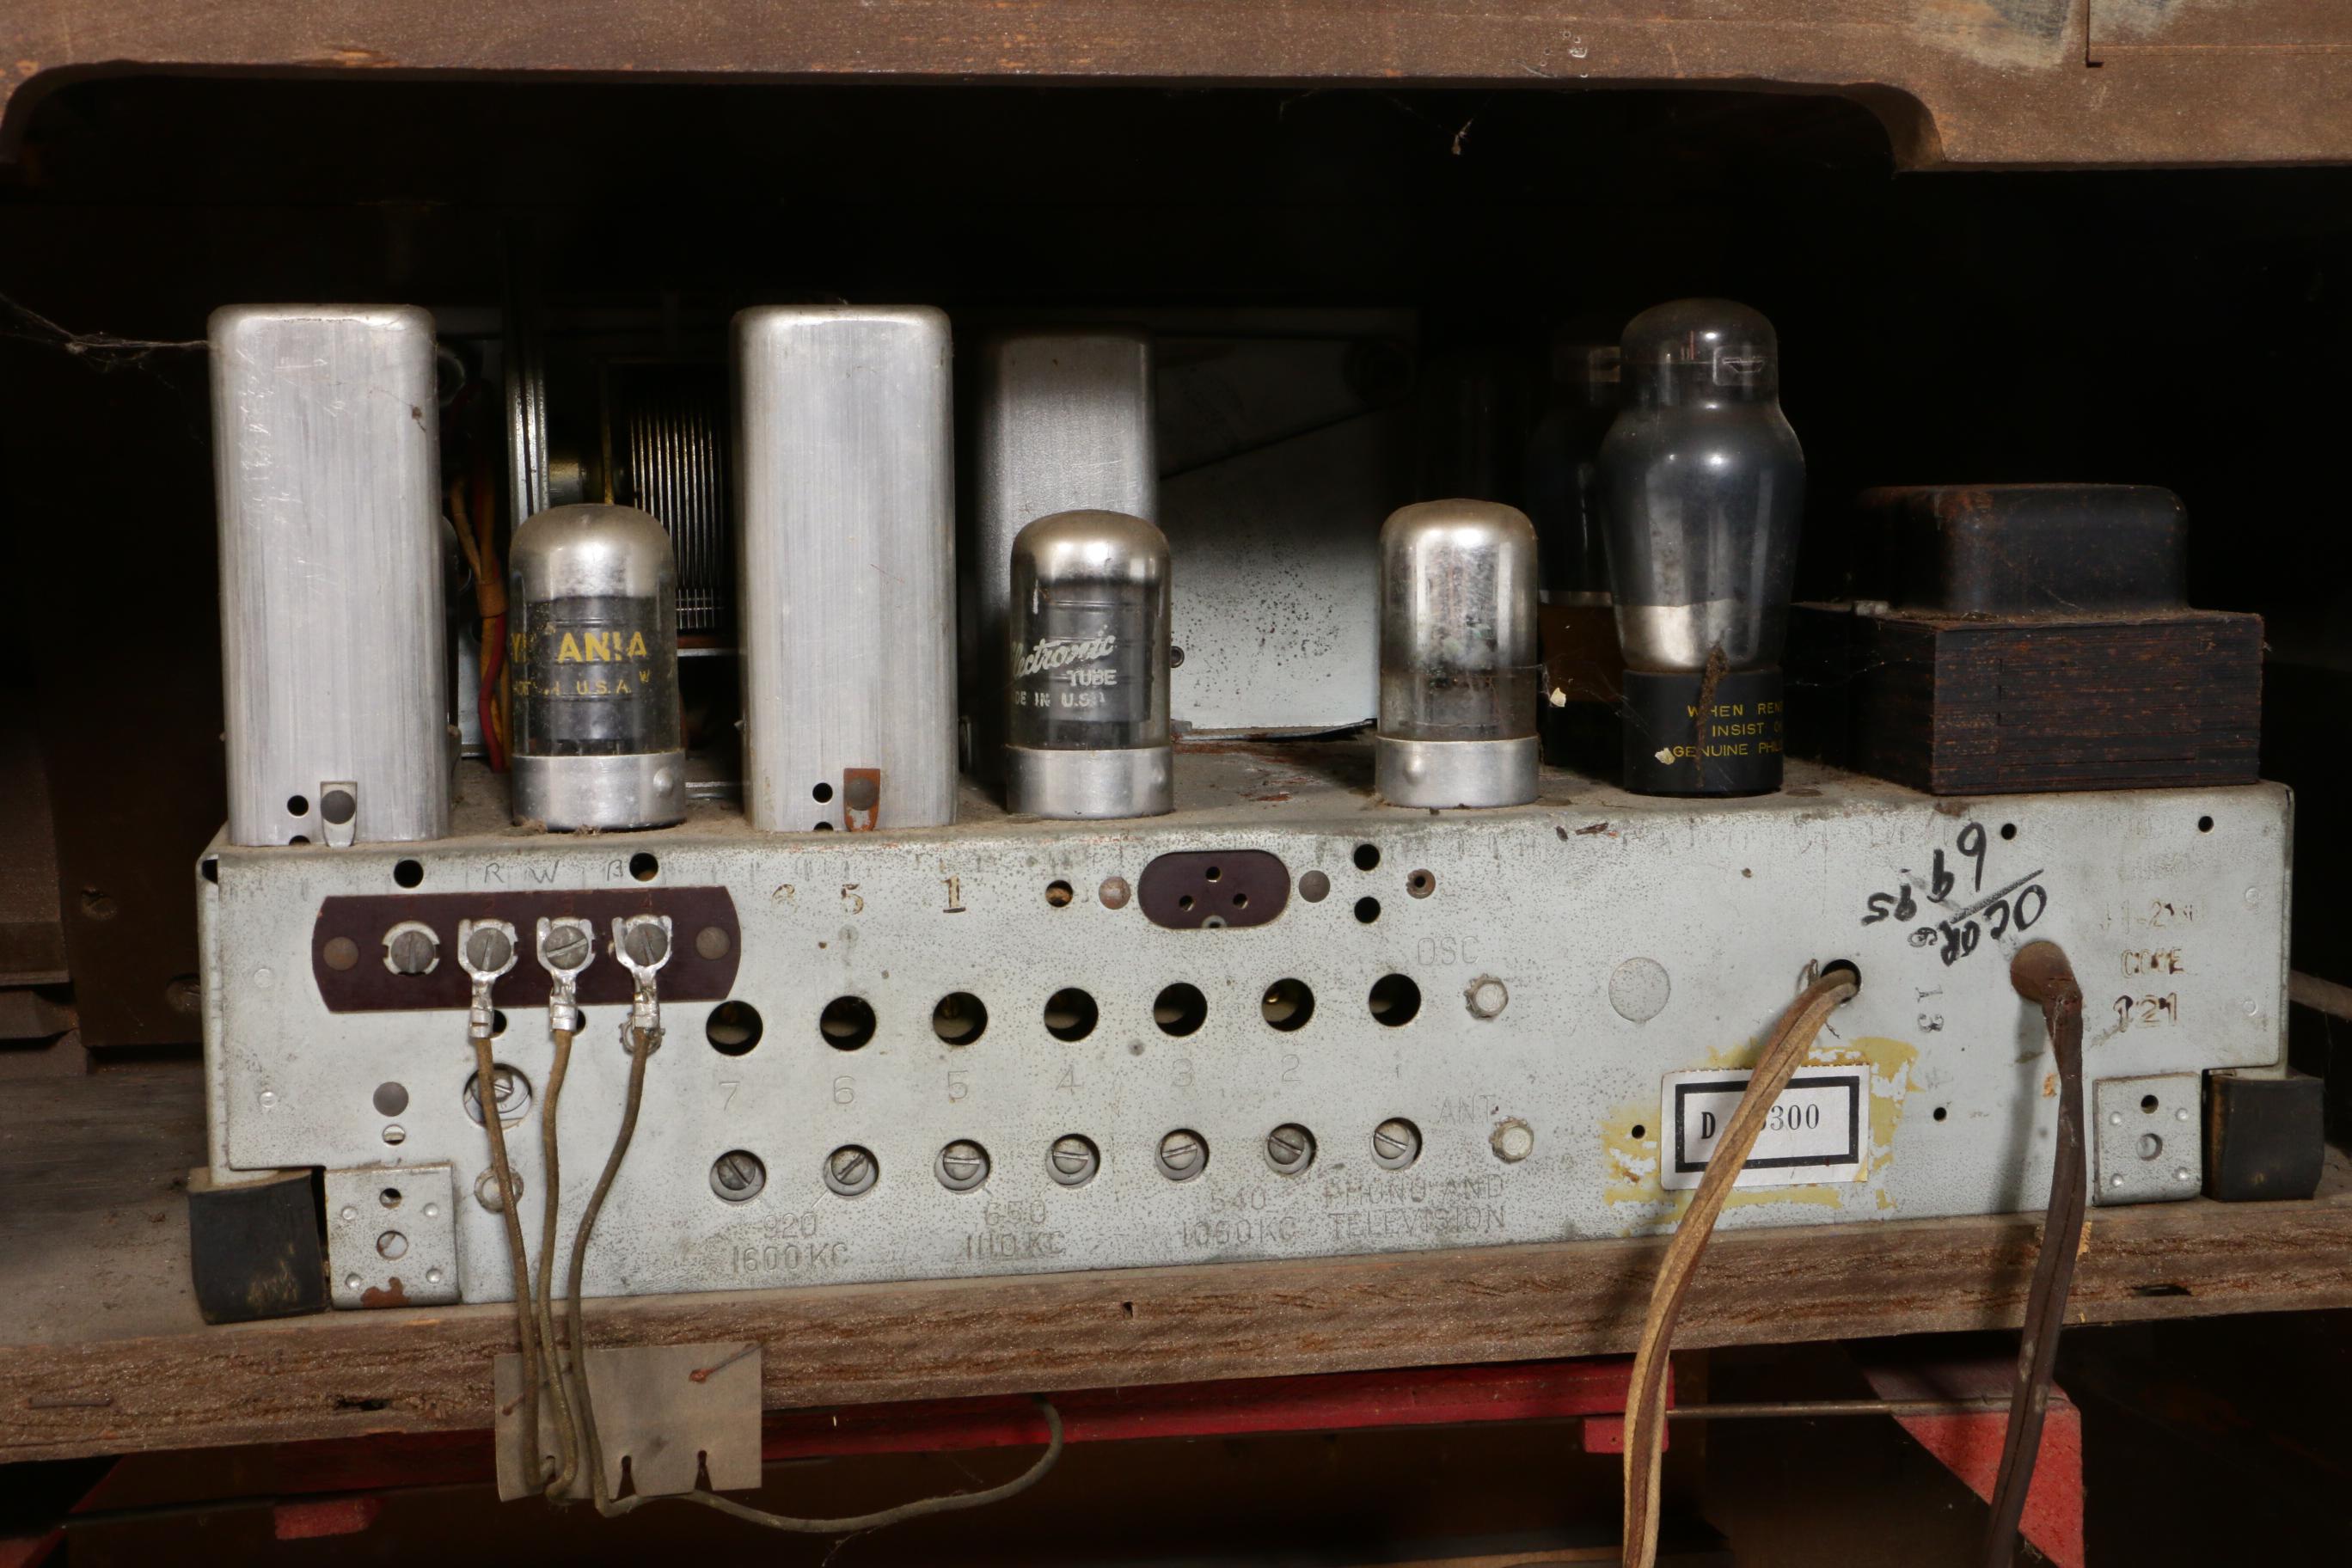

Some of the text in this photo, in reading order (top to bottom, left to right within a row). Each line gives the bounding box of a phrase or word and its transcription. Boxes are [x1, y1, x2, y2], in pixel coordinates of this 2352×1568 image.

[1067, 669, 1118, 687] TUBE
[1034, 691, 1051, 707] IN
[1687, 704, 1744, 718] WHEN
[1712, 722, 1765, 738] INSIST
[1672, 743, 1749, 757] GENUINE
[484, 862, 504, 884] R
[530, 860, 560, 884] W
[840, 883, 864, 916] 5
[940, 875, 967, 914] 1
[1418, 935, 1480, 966] OSC
[1055, 1063, 1083, 1092] 4
[1169, 1057, 1195, 1088] 3
[1281, 1053, 1302, 1083] 2
[718, 1081, 741, 1112] 7
[831, 1075, 856, 1106] 6
[946, 1069, 970, 1100] 5
[1437, 1093, 1496, 1124] ANT
[1700, 1103, 1820, 1140] D 300
[1326, 1204, 1506, 1241] TELEVISION
